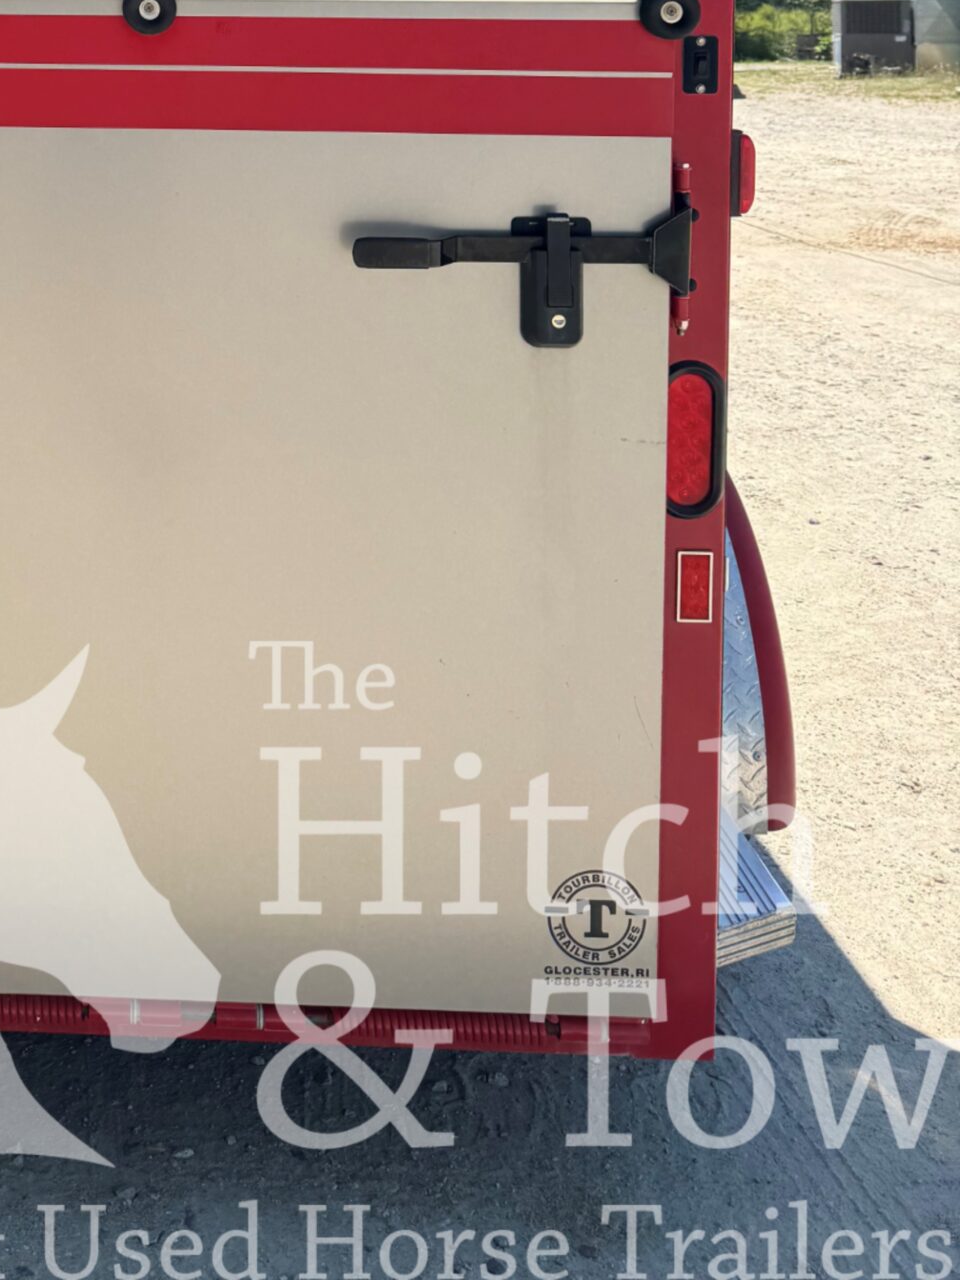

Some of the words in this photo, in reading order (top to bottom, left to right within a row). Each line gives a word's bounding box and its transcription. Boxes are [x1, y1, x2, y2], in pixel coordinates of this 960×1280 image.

[576, 898, 617, 938] T
[554, 923, 600, 961] TRAILER
[608, 925, 640, 959] SALES
